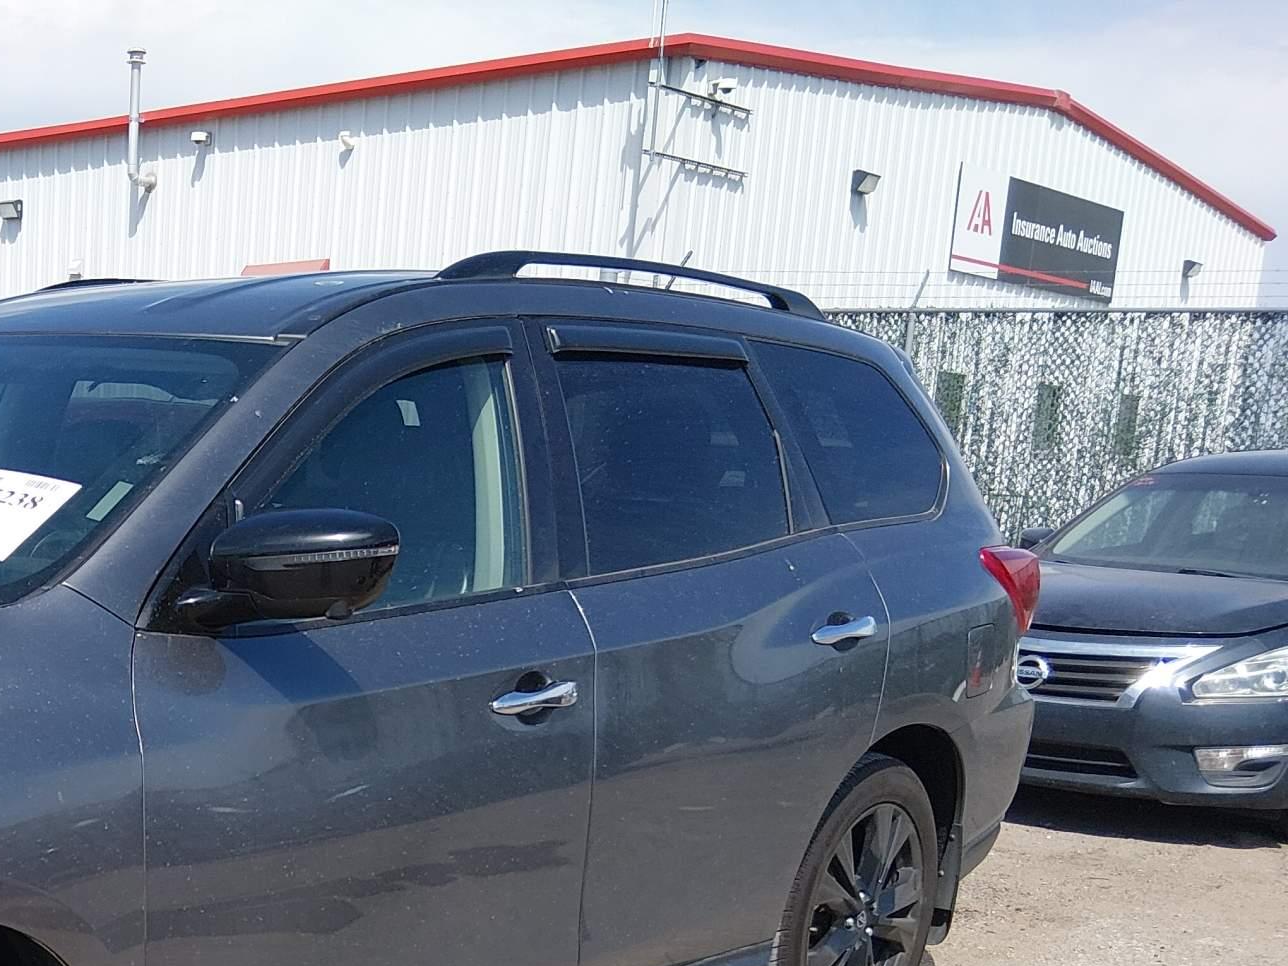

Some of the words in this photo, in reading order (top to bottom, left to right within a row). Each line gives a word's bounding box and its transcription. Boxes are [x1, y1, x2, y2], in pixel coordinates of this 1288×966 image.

[1011, 211, 1055, 244] Insurance
[1056, 224, 1076, 250] Auto
[1076, 230, 1113, 260] Auctions
